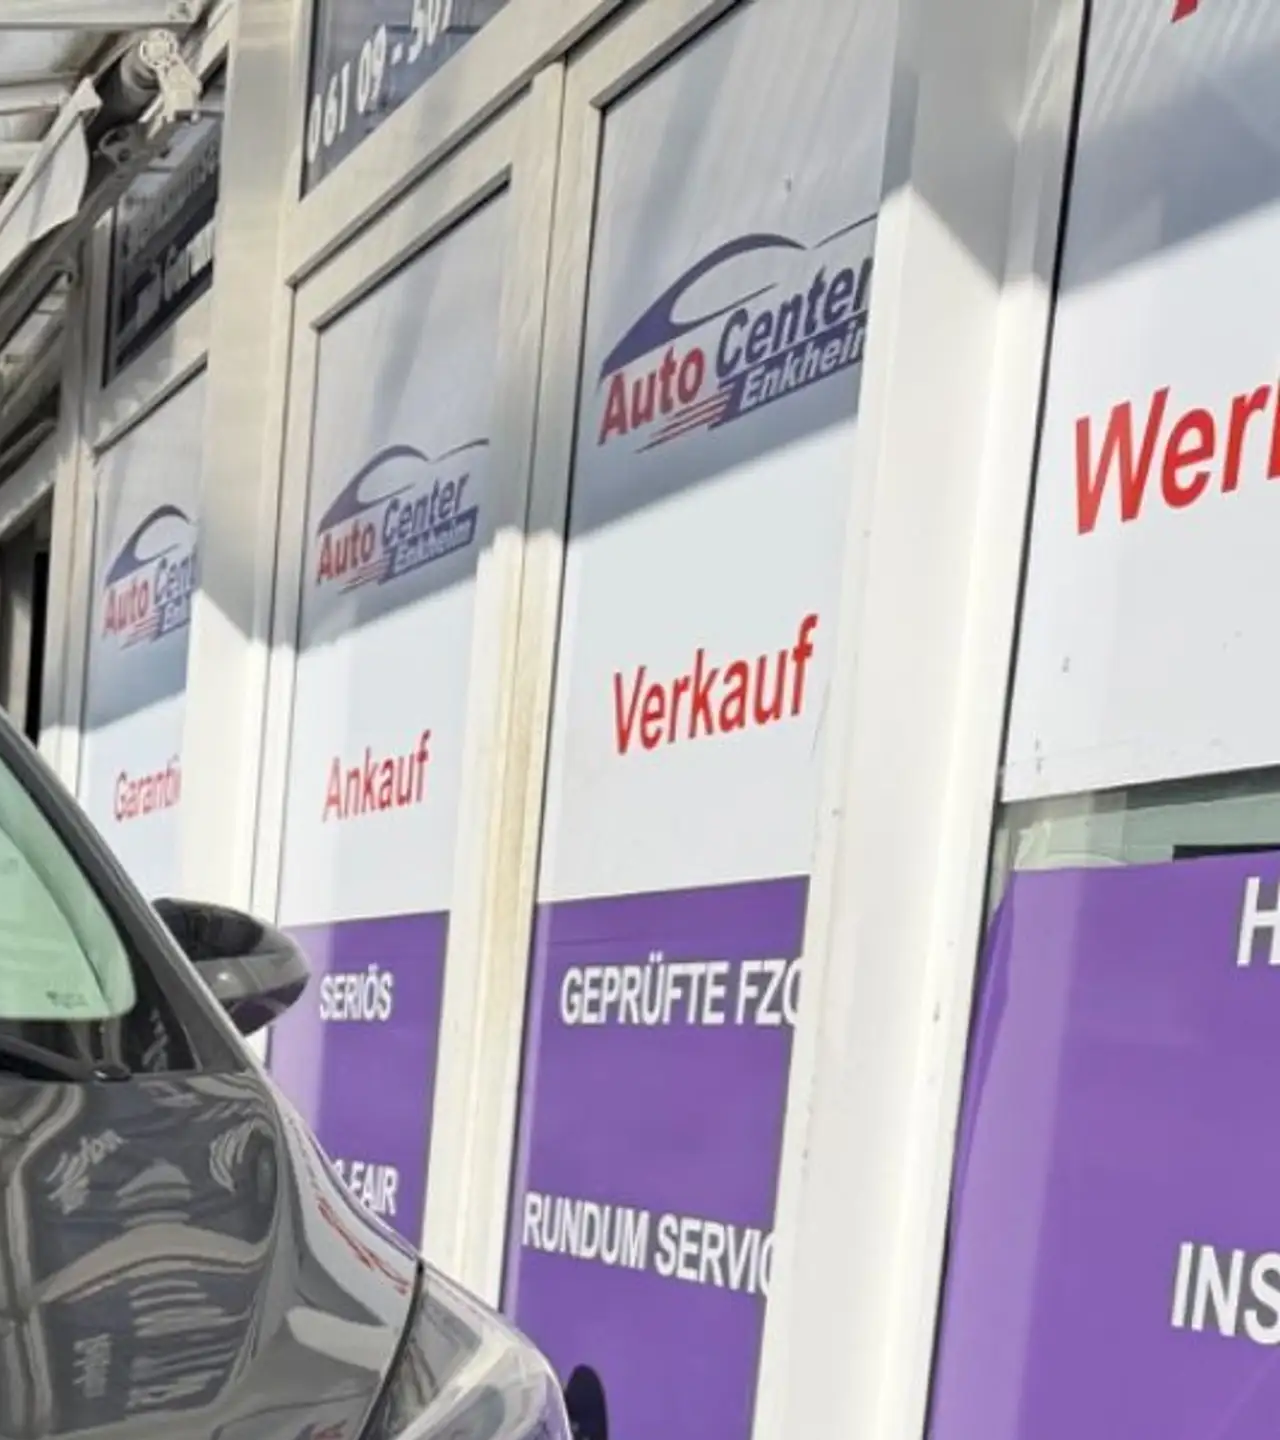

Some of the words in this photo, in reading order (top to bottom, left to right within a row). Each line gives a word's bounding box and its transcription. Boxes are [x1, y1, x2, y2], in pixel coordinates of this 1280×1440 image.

[597, 345, 705, 445] Auto
[716, 256, 873, 380] Center
[316, 519, 376, 585] Auto
[382, 473, 470, 547] Center
[103, 580, 148, 638] Auto
[613, 615, 819, 754] Verkauf
[321, 729, 432, 823] Ankauf
[319, 963, 393, 1021] SERIÖS
[560, 951, 730, 1025] GEPRÜFTE
[522, 1190, 650, 1270] RUNDUM
